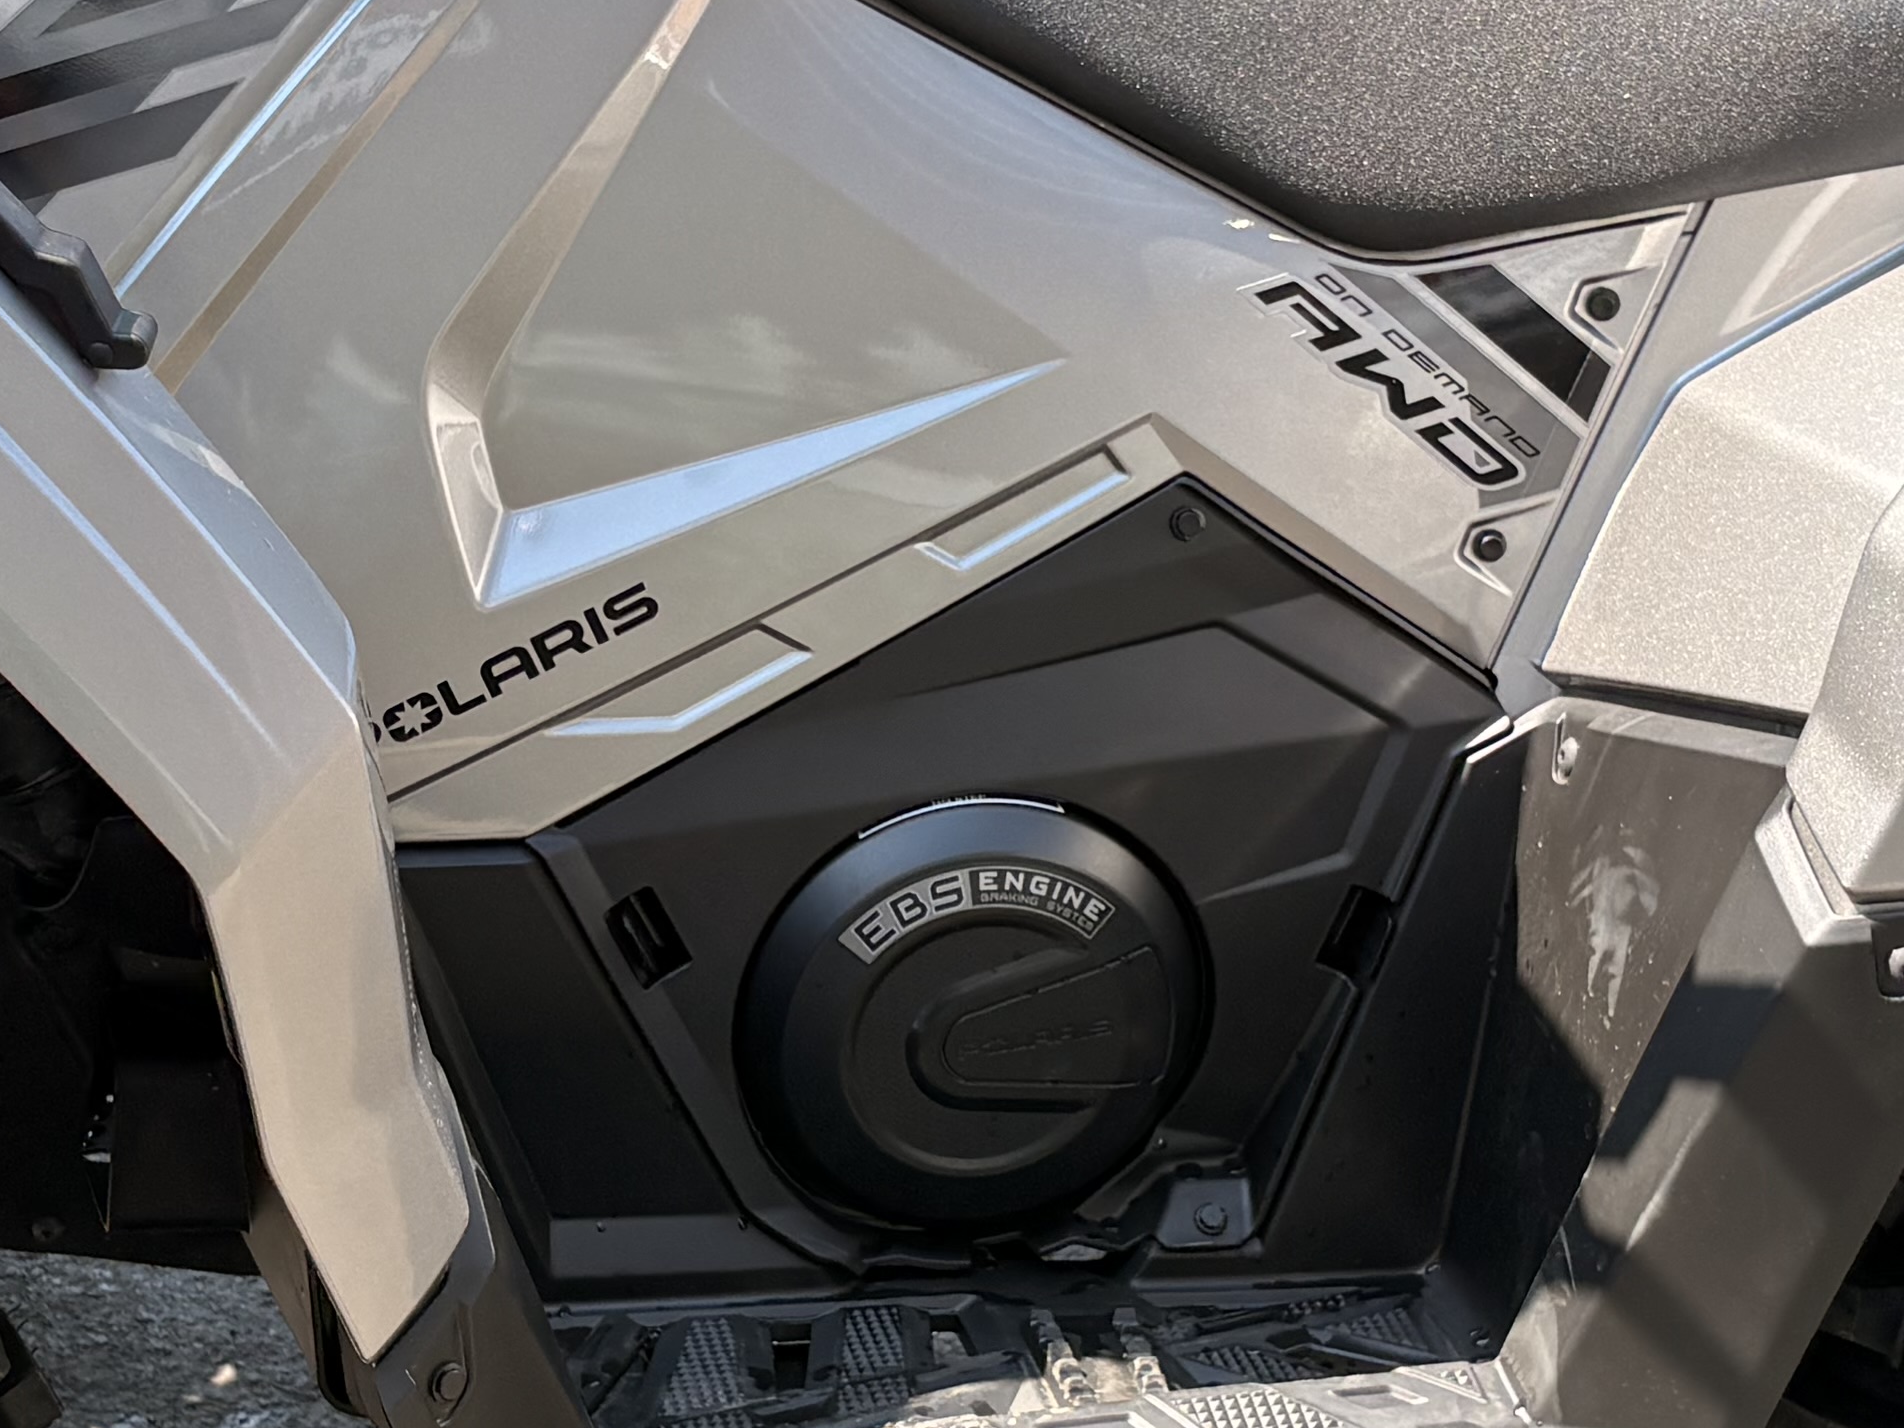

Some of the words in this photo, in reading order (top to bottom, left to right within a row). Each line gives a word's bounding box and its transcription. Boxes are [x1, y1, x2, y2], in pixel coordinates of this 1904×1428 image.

[1256, 280, 1525, 486] AWD
[1313, 272, 1372, 318] ON
[1381, 328, 1540, 459] DEMAND
[371, 582, 659, 745] OLARIS
[853, 873, 965, 954] EBS
[978, 871, 1106, 921] ENGINE
[980, 892, 1039, 906] BRAKING
